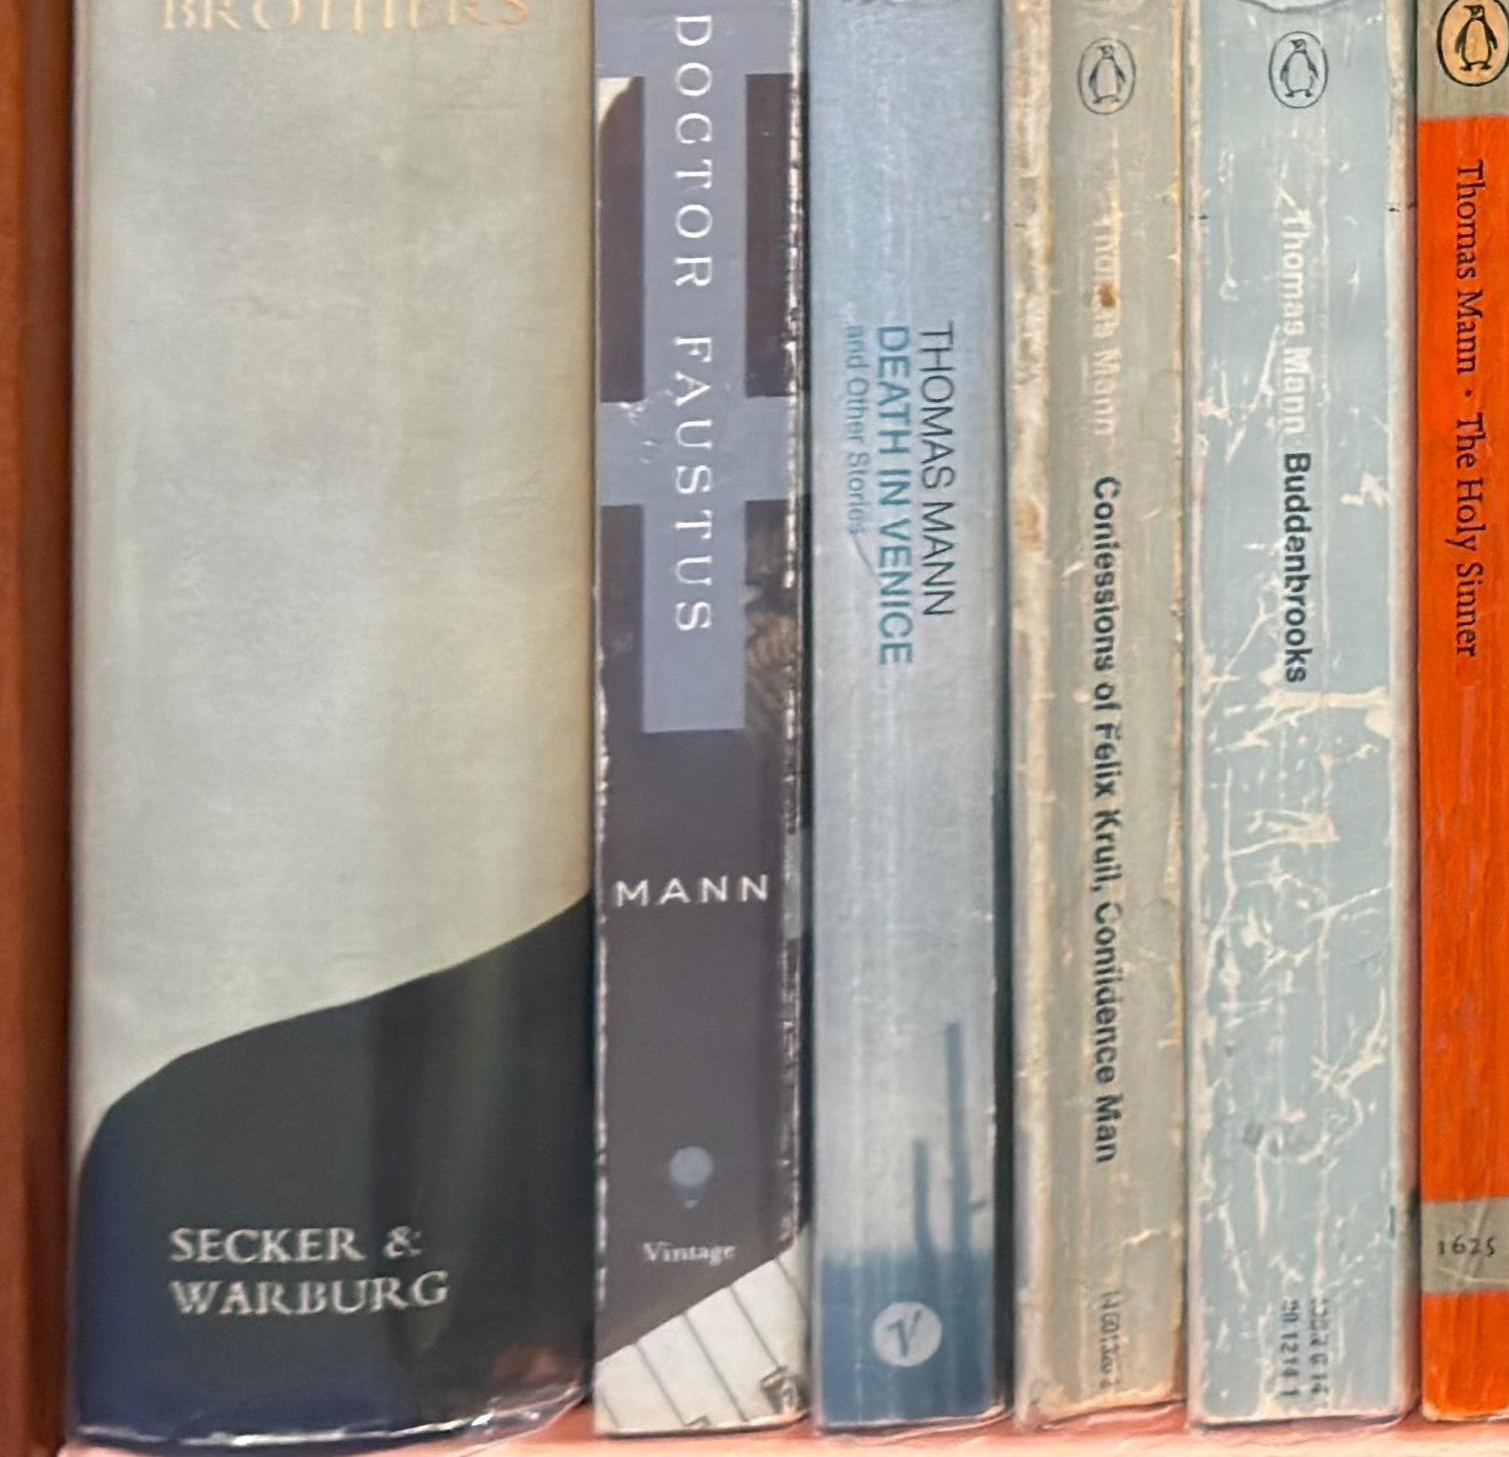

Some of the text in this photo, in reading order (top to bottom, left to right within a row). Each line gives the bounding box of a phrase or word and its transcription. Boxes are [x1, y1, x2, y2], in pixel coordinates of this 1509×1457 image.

[674, 16, 714, 632] DOCTOR FAUSTUS
[846, 325, 867, 535] and Other Stories
[919, 320, 957, 617] THOMAS MANN
[1281, 211, 1312, 683] Thomas Mann Buddenbrooks
[1446, 160, 1485, 655] Thomas Mann The Holy Sinner
[877, 325, 914, 666] DEATH IN VENICE
[1094, 476, 1121, 674] Confessions
[1094, 684, 1121, 713] of
[1094, 724, 1121, 797] Felix
[615, 875, 769, 906] MANN
[1094, 904, 1121, 1083] Confidence
[1094, 1095, 1120, 1163] Man
[170, 1226, 421, 1263] SECKER &
[170, 1271, 448, 1315] WARBURG
[643, 1240, 735, 1264] Vintage
[1437, 1235, 1495, 1259] 1625
